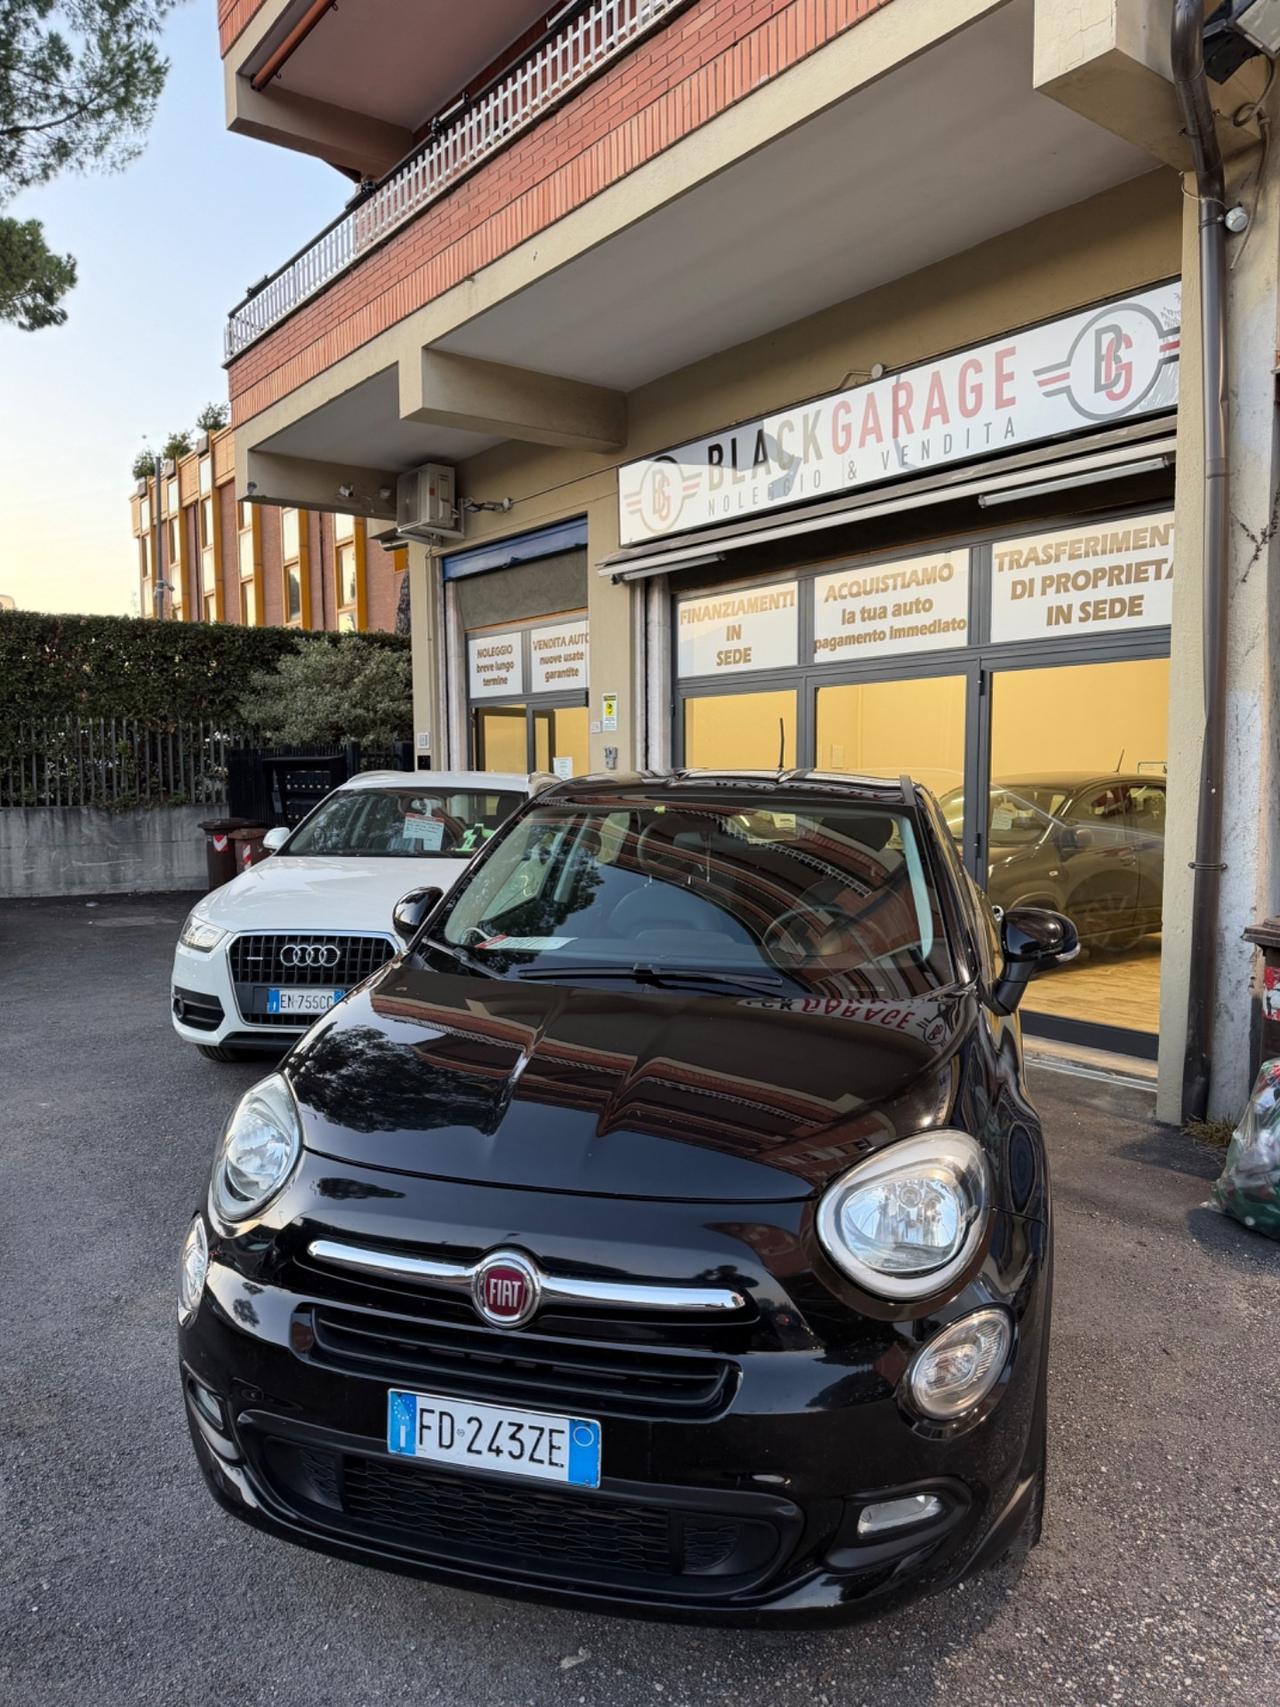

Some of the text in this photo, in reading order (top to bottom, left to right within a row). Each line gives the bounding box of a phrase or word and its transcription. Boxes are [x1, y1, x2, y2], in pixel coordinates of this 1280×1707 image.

[848, 460, 857, 480] &
[881, 416, 1015, 470] VENDITA
[824, 563, 954, 602] ACQUISTIAMO
[1011, 578, 1035, 600] DI
[680, 590, 795, 624] FINANZIAMENTI
[841, 597, 933, 625] la tua auto
[1046, 595, 1144, 626] IN SEDE
[533, 637, 567, 651] VENDITA
[726, 624, 742, 641] IN
[815, 616, 966, 653] pagamento immediato
[477, 644, 513, 658] NOLEGGIO
[563, 650, 584, 662] usate
[716, 647, 752, 666] SEDE
[476, 663, 494, 673] breve
[489, 1278, 522, 1308] FIAT
